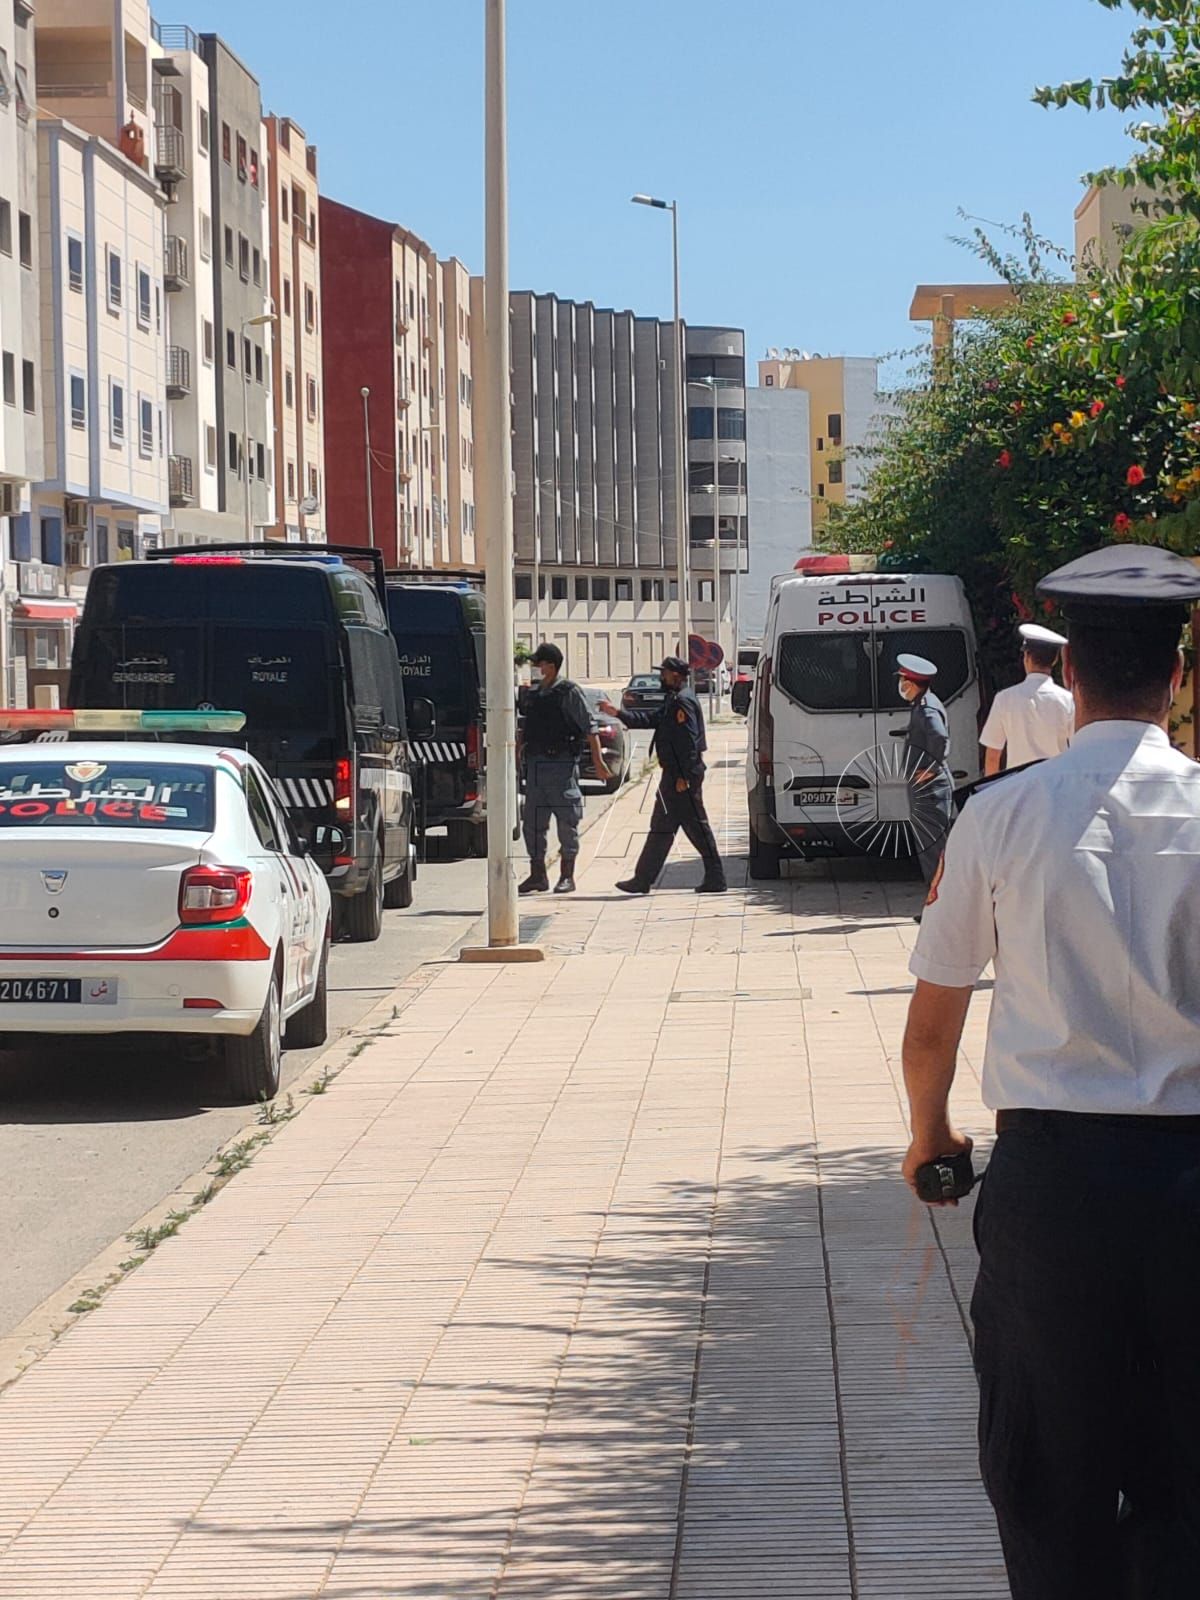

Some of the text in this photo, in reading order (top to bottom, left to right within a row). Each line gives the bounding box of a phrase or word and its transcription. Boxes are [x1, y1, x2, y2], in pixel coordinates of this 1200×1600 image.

[817, 587, 925, 608] الشرطة
[818, 609, 927, 625] POLICE
[252, 671, 288, 682] ROYALE
[801, 792, 836, 803] 209872
[0, 801, 168, 822] OLICE
[0, 980, 69, 1000] 204671
[90, 980, 108, 997] ش
